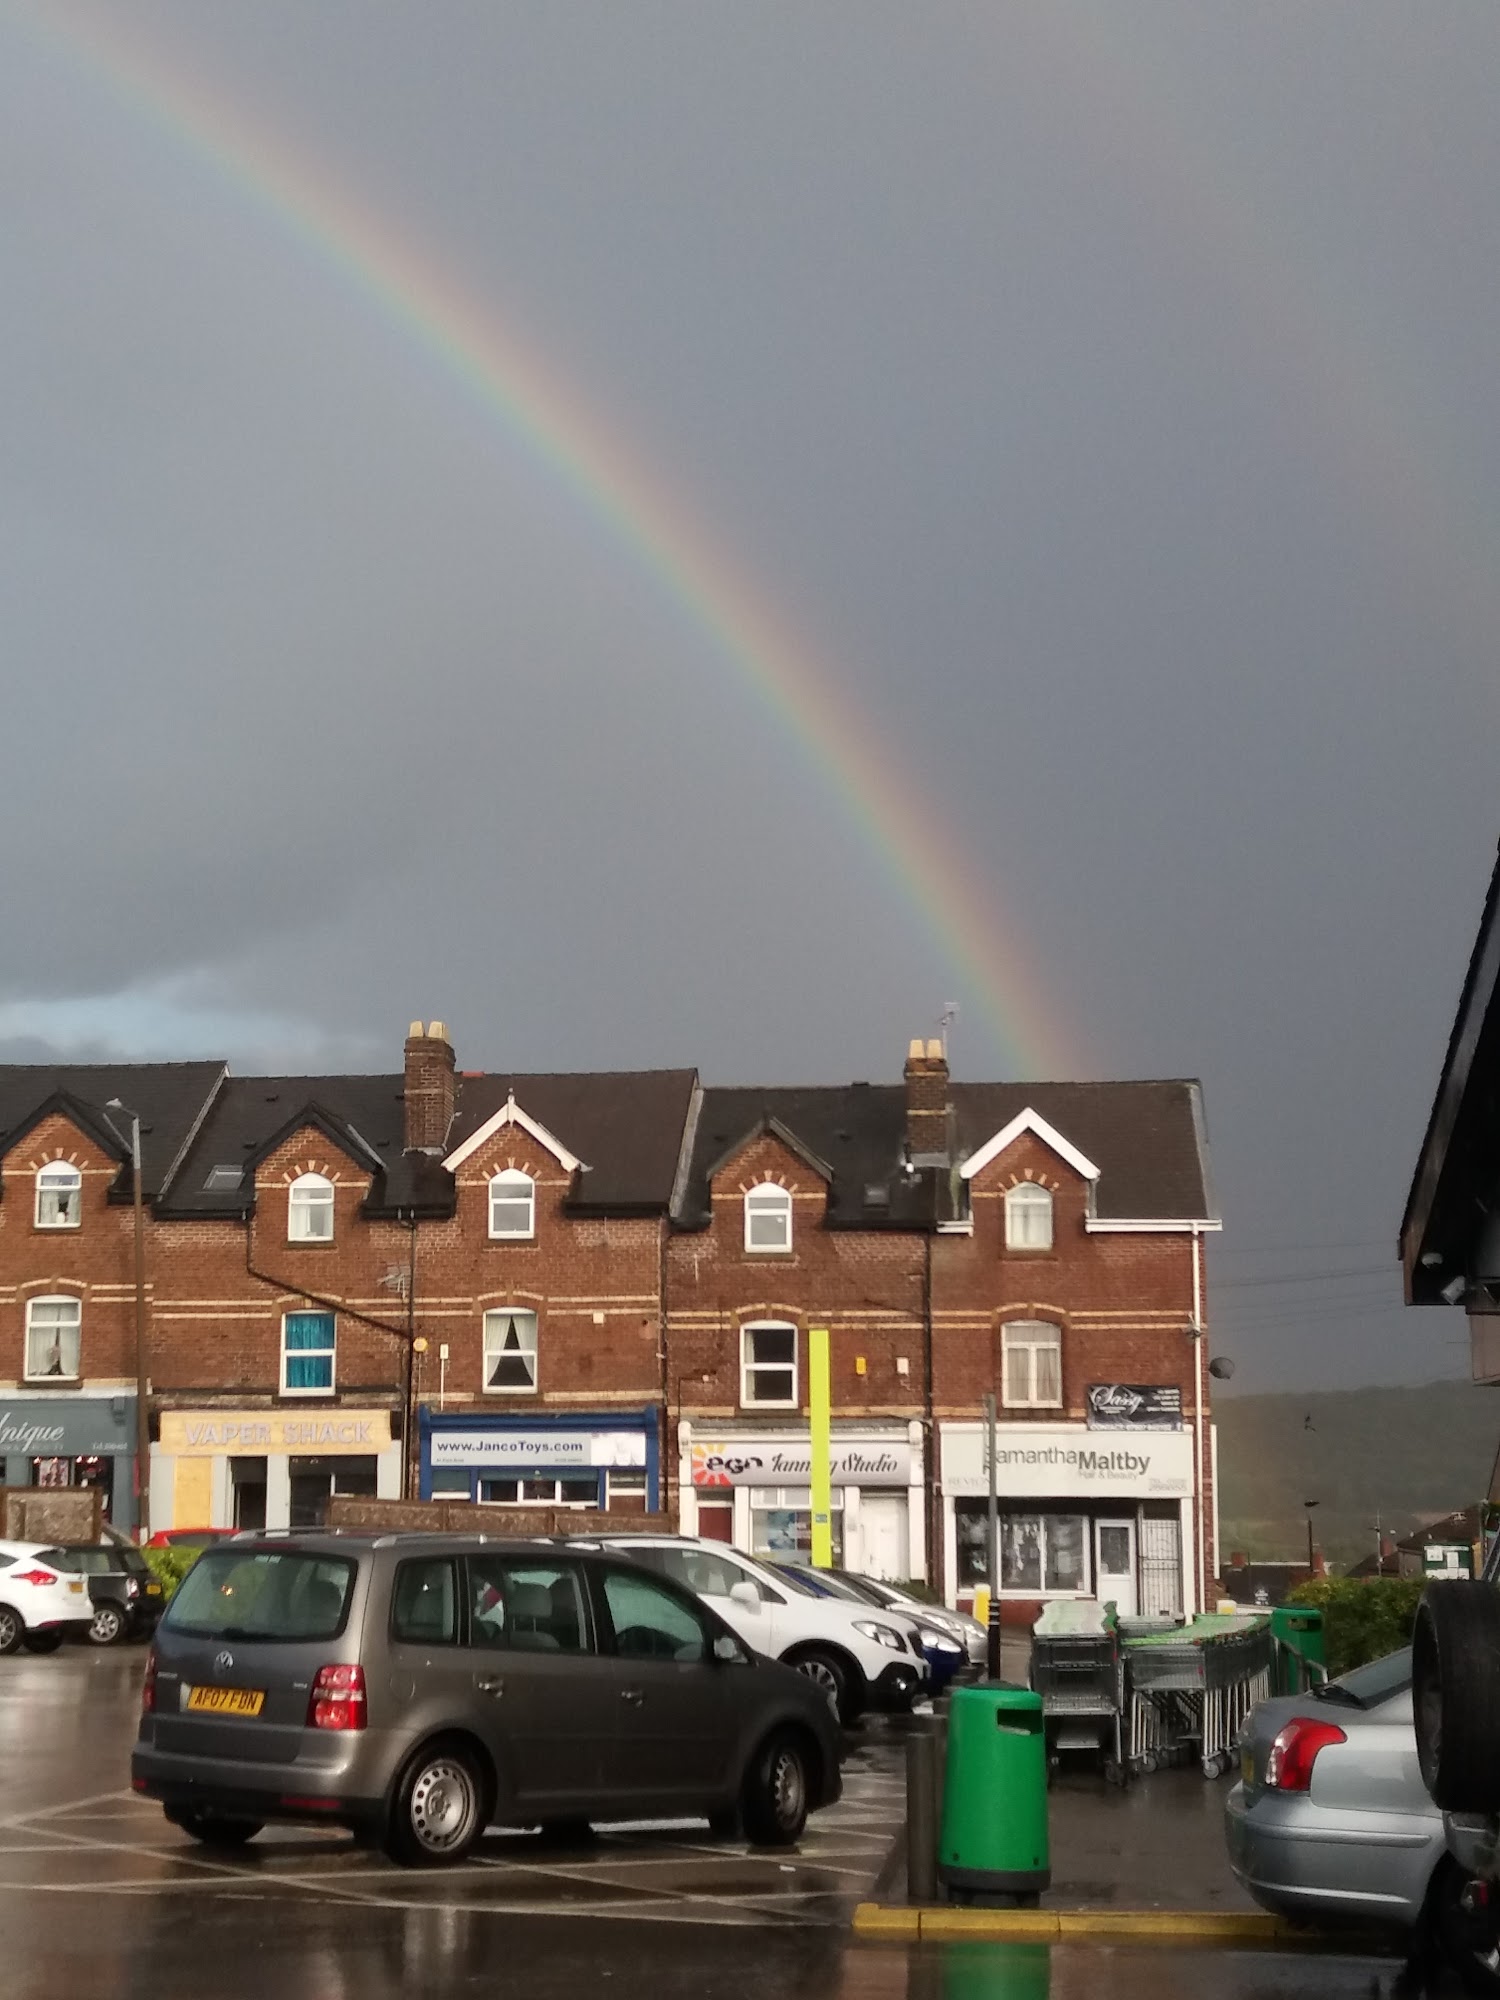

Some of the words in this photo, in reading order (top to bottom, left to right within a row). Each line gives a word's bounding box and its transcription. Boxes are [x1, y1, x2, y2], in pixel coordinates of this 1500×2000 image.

[185, 1422, 271, 1445] VAPER
[283, 1421, 371, 1444] SHACK
[437, 1440, 583, 1454] www.JancoToys.com
[771, 1453, 836, 1476] Tanng
[842, 1453, 898, 1472] Studio
[987, 1446, 1077, 1464] amantha
[1078, 1451, 1151, 1475] Maltby
